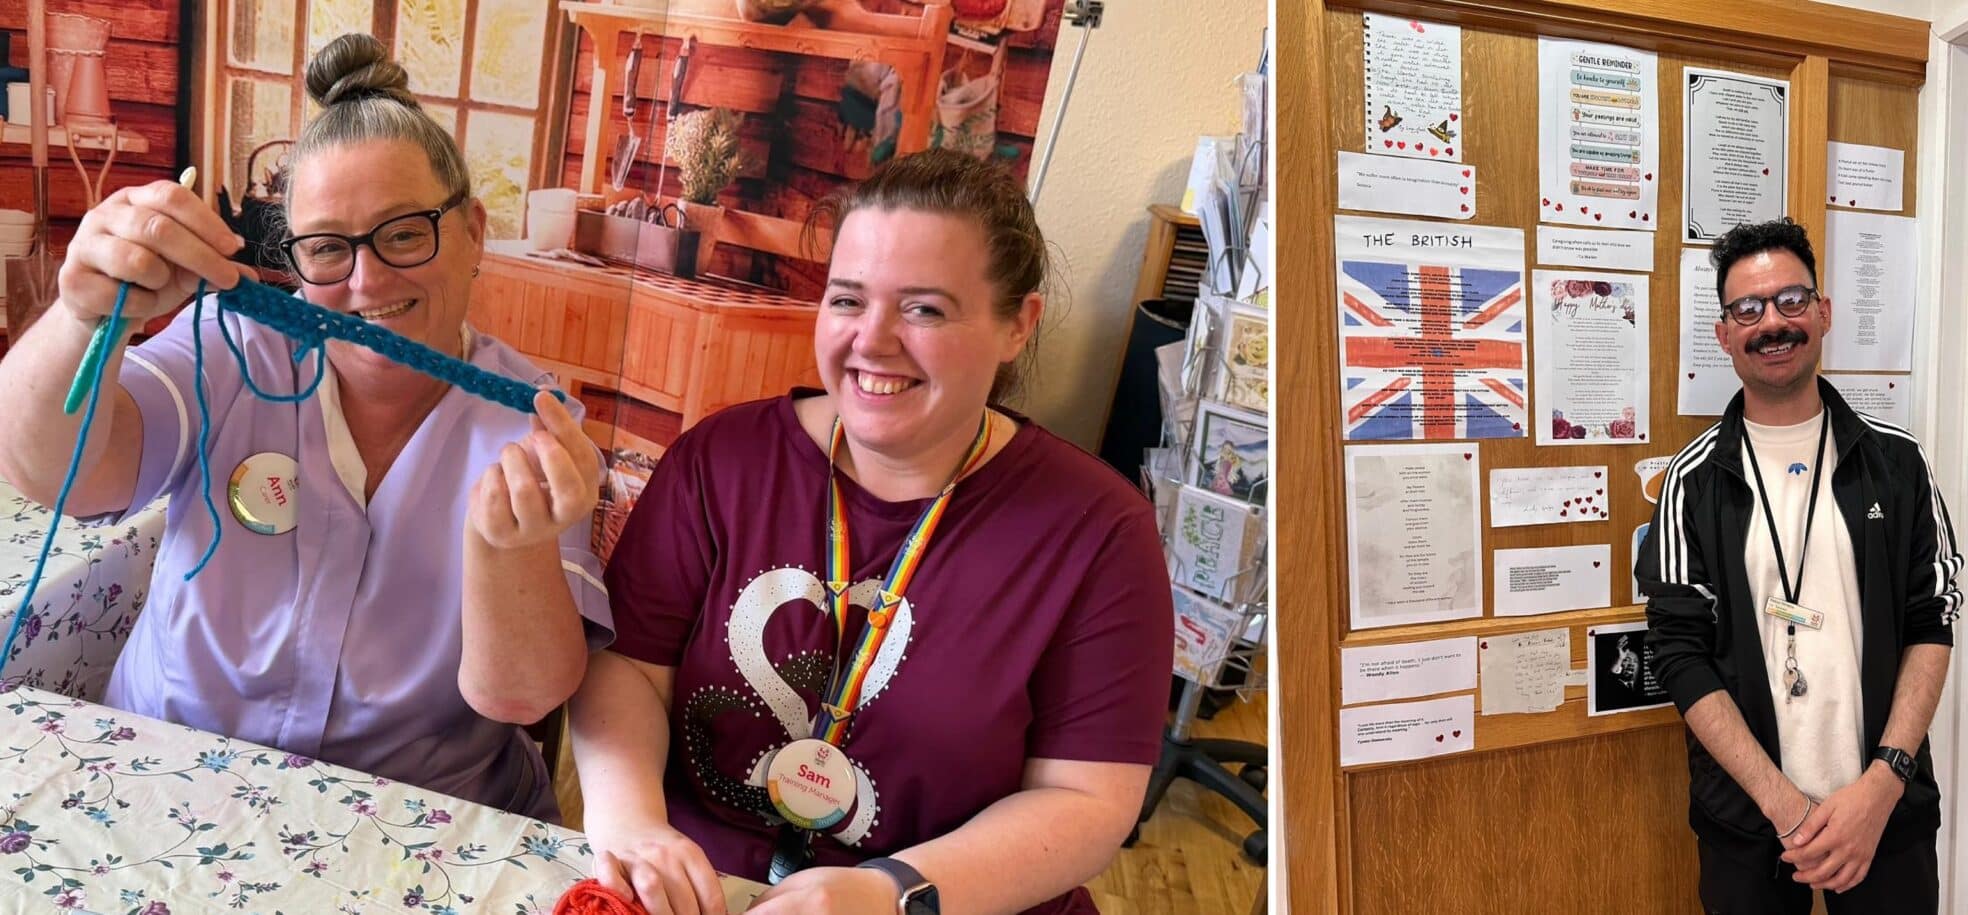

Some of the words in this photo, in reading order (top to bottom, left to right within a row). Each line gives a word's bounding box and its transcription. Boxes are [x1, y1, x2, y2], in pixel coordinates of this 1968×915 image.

[1579, 55, 1601, 66] GENTLE
[1602, 58, 1632, 70] REMINDER
[1363, 232, 1395, 248] THE
[1411, 234, 1472, 249] BRITISH
[267, 476, 287, 507] Ann
[1192, 505, 1226, 592] PEACE
[779, 773, 808, 793] Training
[808, 787, 841, 806] Manager
[797, 763, 832, 789] Sam
